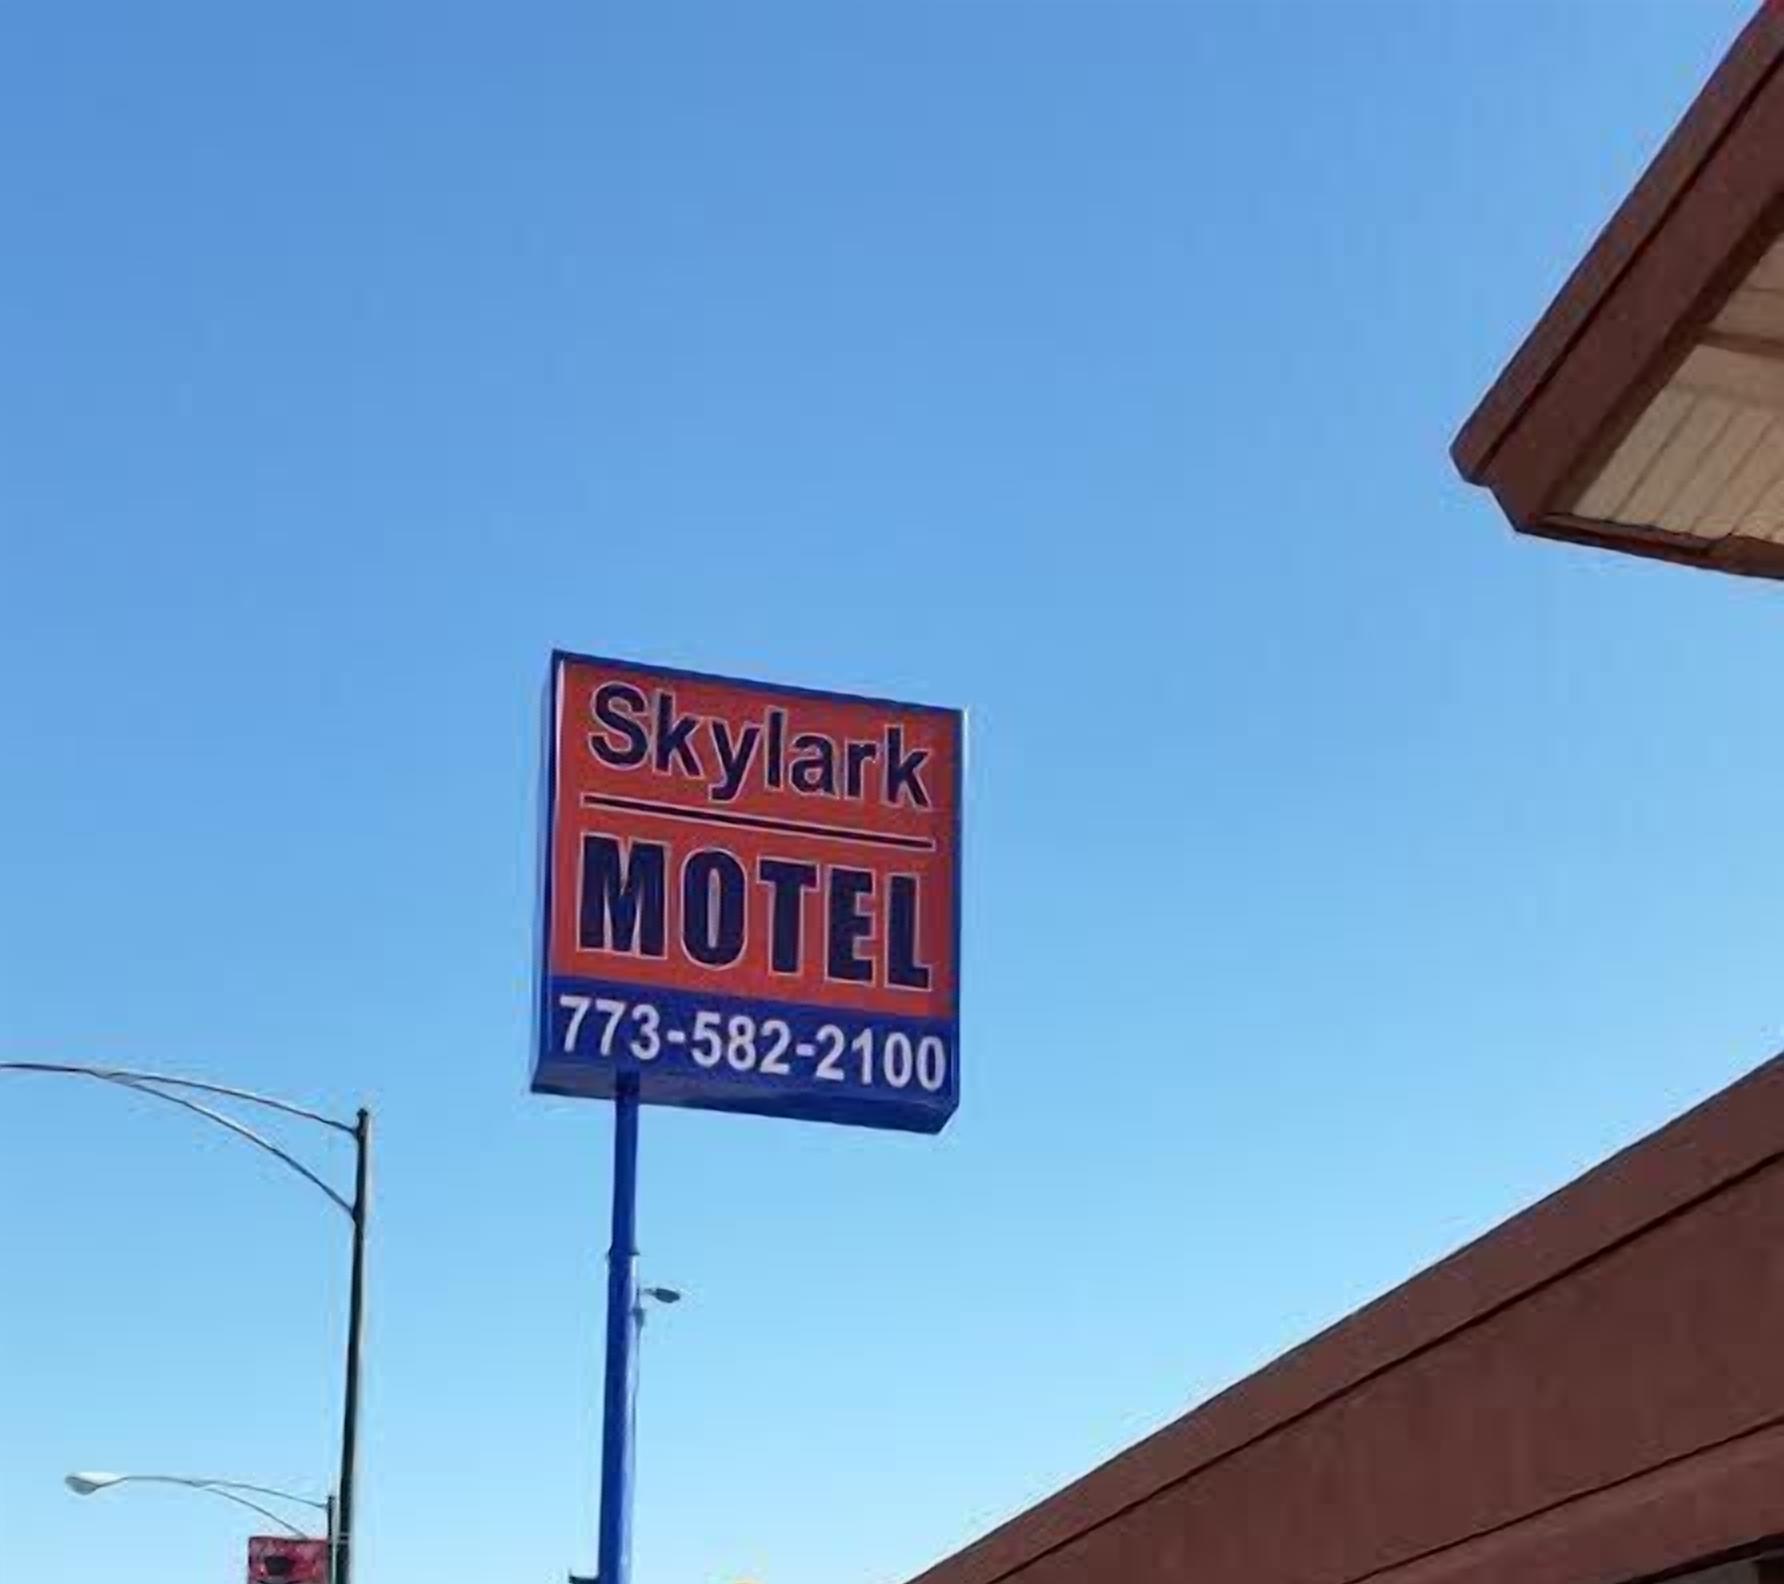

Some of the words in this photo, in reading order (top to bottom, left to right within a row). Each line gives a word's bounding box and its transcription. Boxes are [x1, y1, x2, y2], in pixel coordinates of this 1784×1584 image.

[588, 681, 932, 810] Skylark
[577, 832, 932, 992] MOTEL
[559, 995, 947, 1092] 773-582-2100
